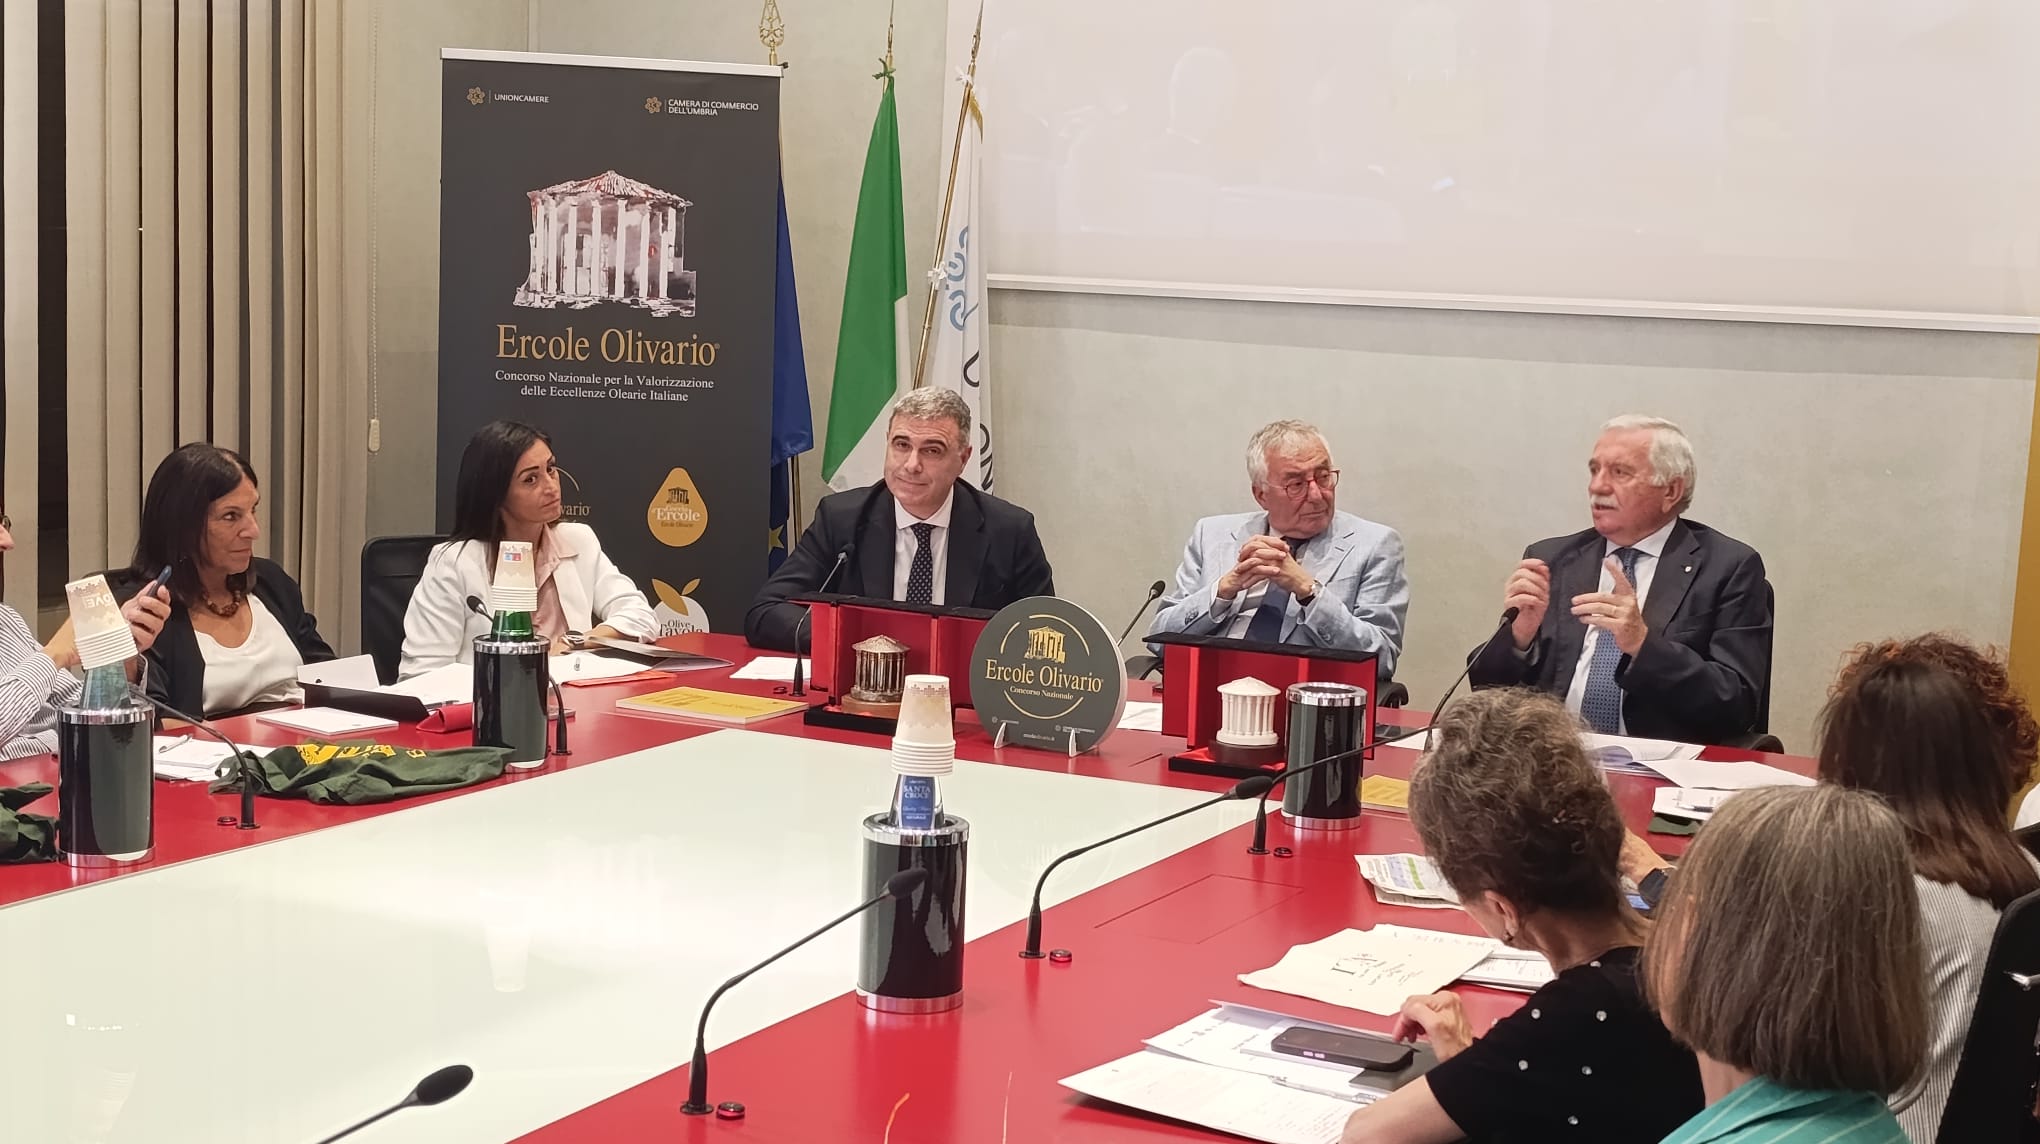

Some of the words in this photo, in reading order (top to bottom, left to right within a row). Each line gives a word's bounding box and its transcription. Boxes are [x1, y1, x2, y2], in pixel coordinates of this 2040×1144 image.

[494, 93, 549, 103] UNIONCAMERE
[668, 99, 701, 108] CAMERA
[710, 101, 759, 110] COMMERCIO
[668, 106, 718, 116] DELL'UMBRIA
[496, 324, 590, 361] Ercole
[495, 369, 546, 382] Concorso
[549, 372, 602, 384] Nazionale
[604, 376, 622, 387] per
[624, 374, 634, 386] la
[636, 375, 714, 389] Valorizzazione
[520, 385, 547, 396] delle
[549, 386, 606, 399] Eccellenze
[608, 388, 647, 400] Olearie
[650, 390, 689, 402] Italiane
[667, 619, 691, 629] Olive
[985, 658, 1035, 685] Ercole
[1039, 665, 1103, 693] Olivario
[1009, 685, 1041, 697] Concorso
[1041, 689, 1074, 701] Nazionale
[903, 784, 931, 793] SANTA
